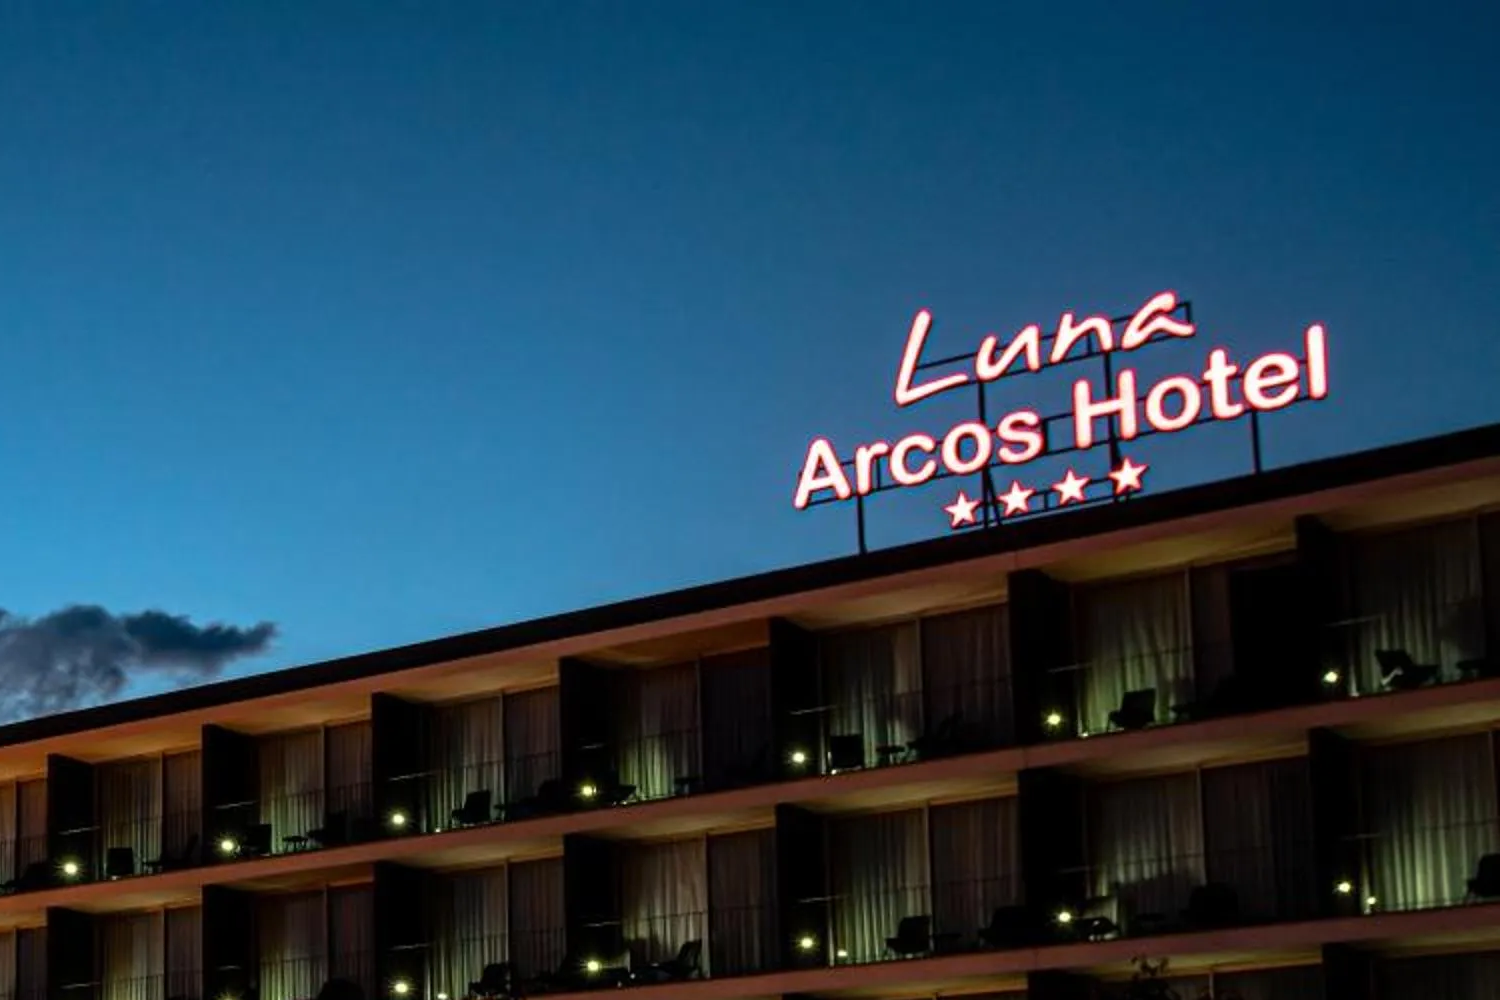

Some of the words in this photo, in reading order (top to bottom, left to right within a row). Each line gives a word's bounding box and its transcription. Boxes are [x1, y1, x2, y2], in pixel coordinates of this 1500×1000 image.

[793, 411, 1045, 510] Arcos
[1072, 322, 1329, 449] Hotel
[894, 289, 1195, 407] Luna
